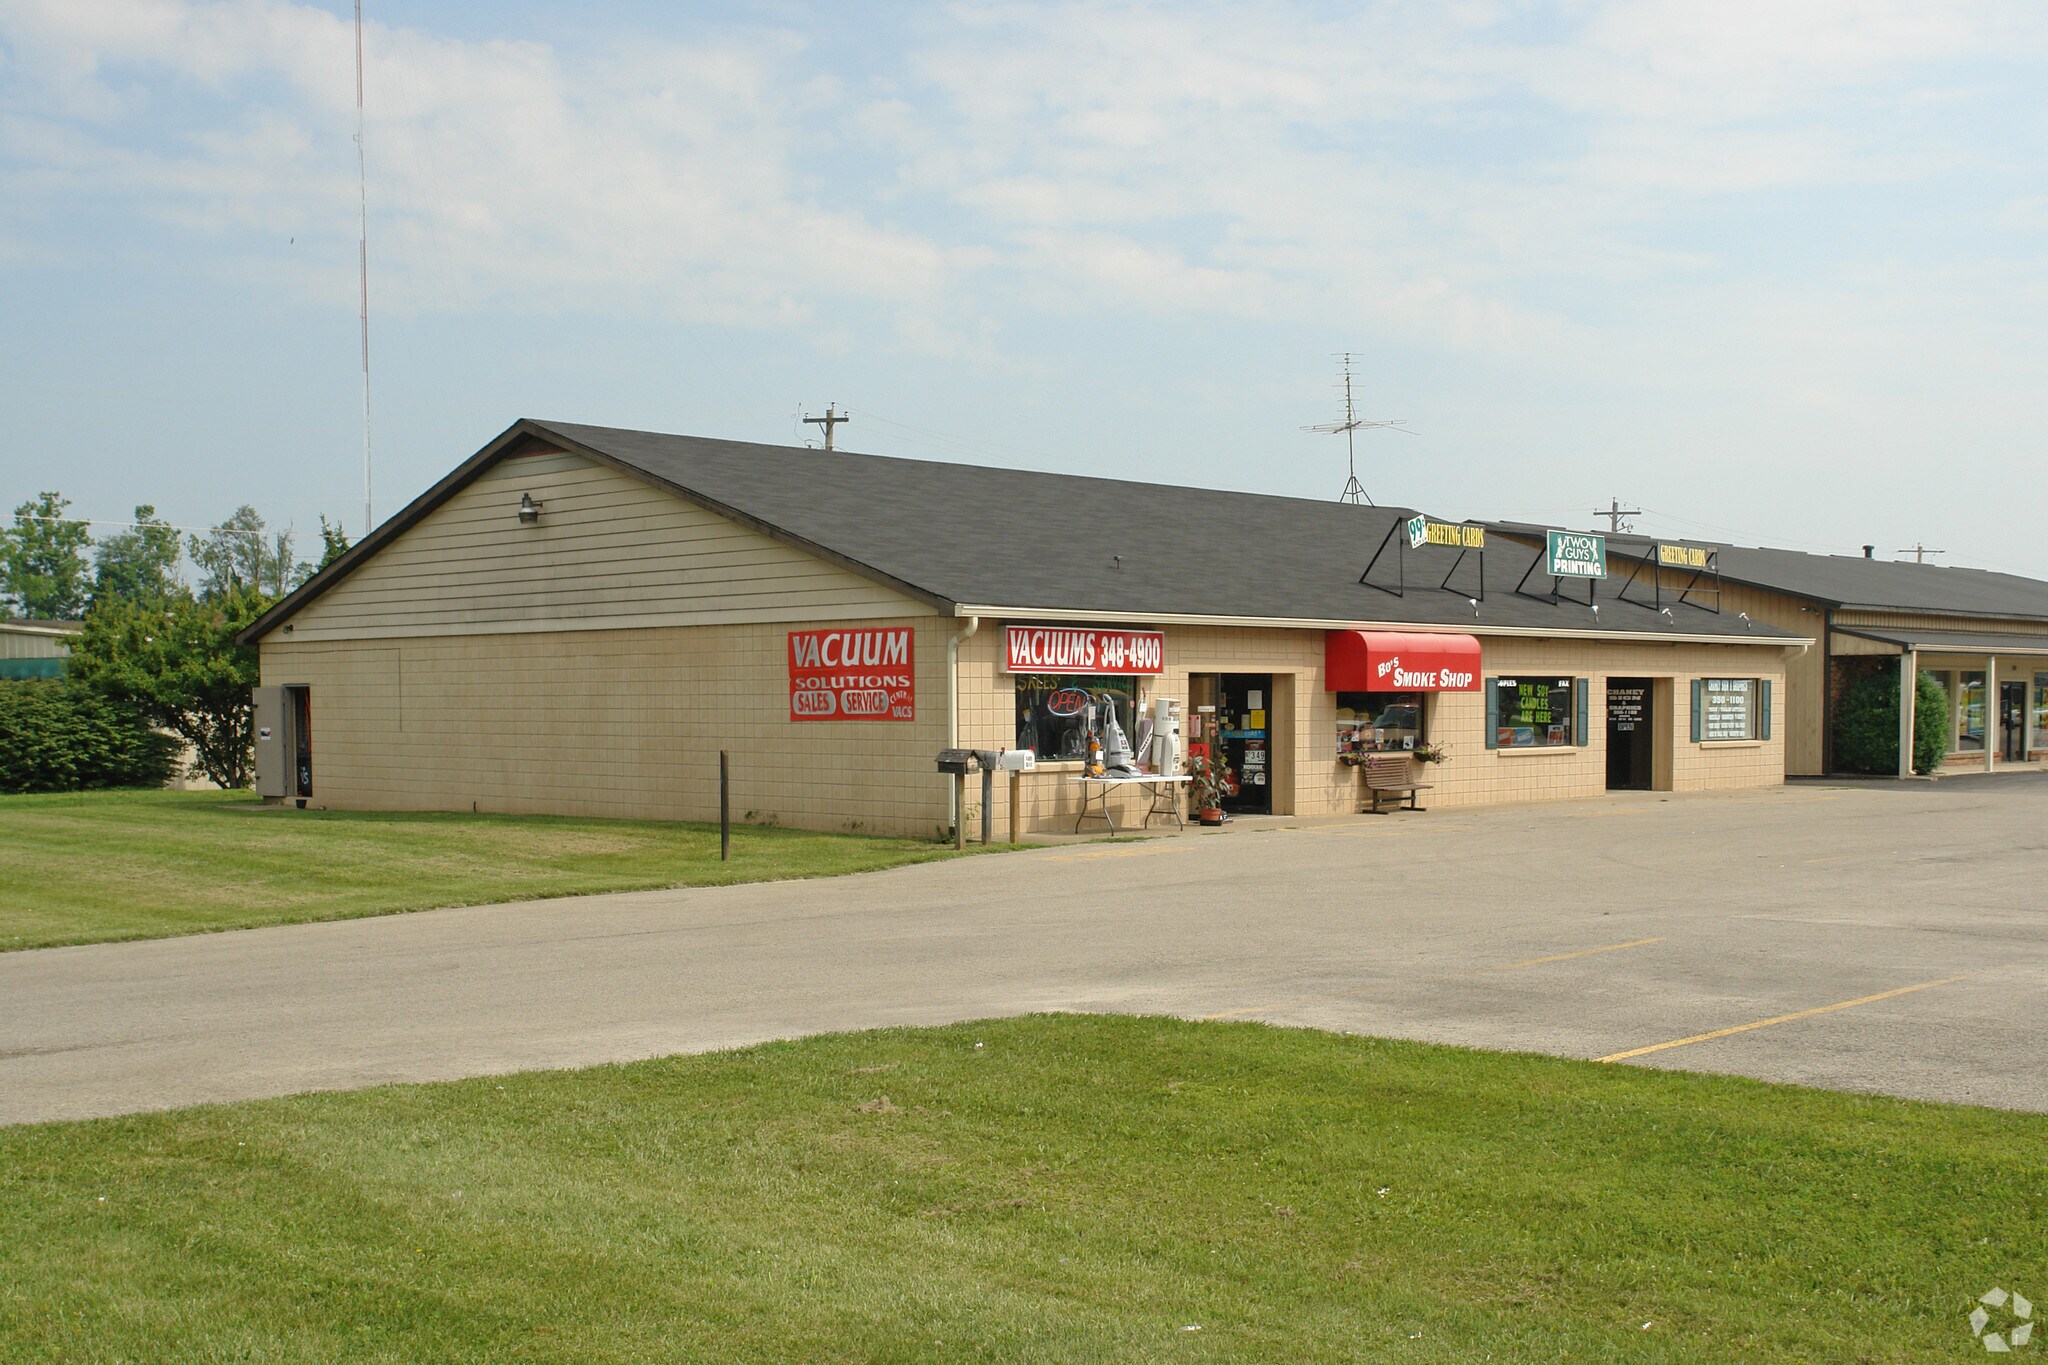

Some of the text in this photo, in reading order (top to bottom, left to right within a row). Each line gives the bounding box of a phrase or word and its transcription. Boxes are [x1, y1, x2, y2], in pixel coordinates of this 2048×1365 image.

[1426, 523, 1484, 548] GREETING CARDS
[1564, 535, 1590, 548] TWO
[1565, 547, 1590, 560] GUYS
[1660, 544, 1706, 567] GREETING CARDS
[1553, 558, 1602, 576] PRINTING
[792, 631, 909, 668] VACUUM
[1010, 630, 1161, 669] VACUUMS 348-4900
[795, 675, 911, 690] SOLUTIONS
[1018, 674, 1059, 691] SALES
[1518, 684, 1550, 697] NEW SOY
[1558, 680, 1570, 688] FAX
[798, 692, 830, 712] SALES
[846, 691, 884, 713] SERVICE
[1048, 690, 1087, 713] OPEN
[1520, 696, 1548, 710] CANDLES
[892, 706, 912, 718] VACS
[1520, 710, 1552, 723] ARE HERE
